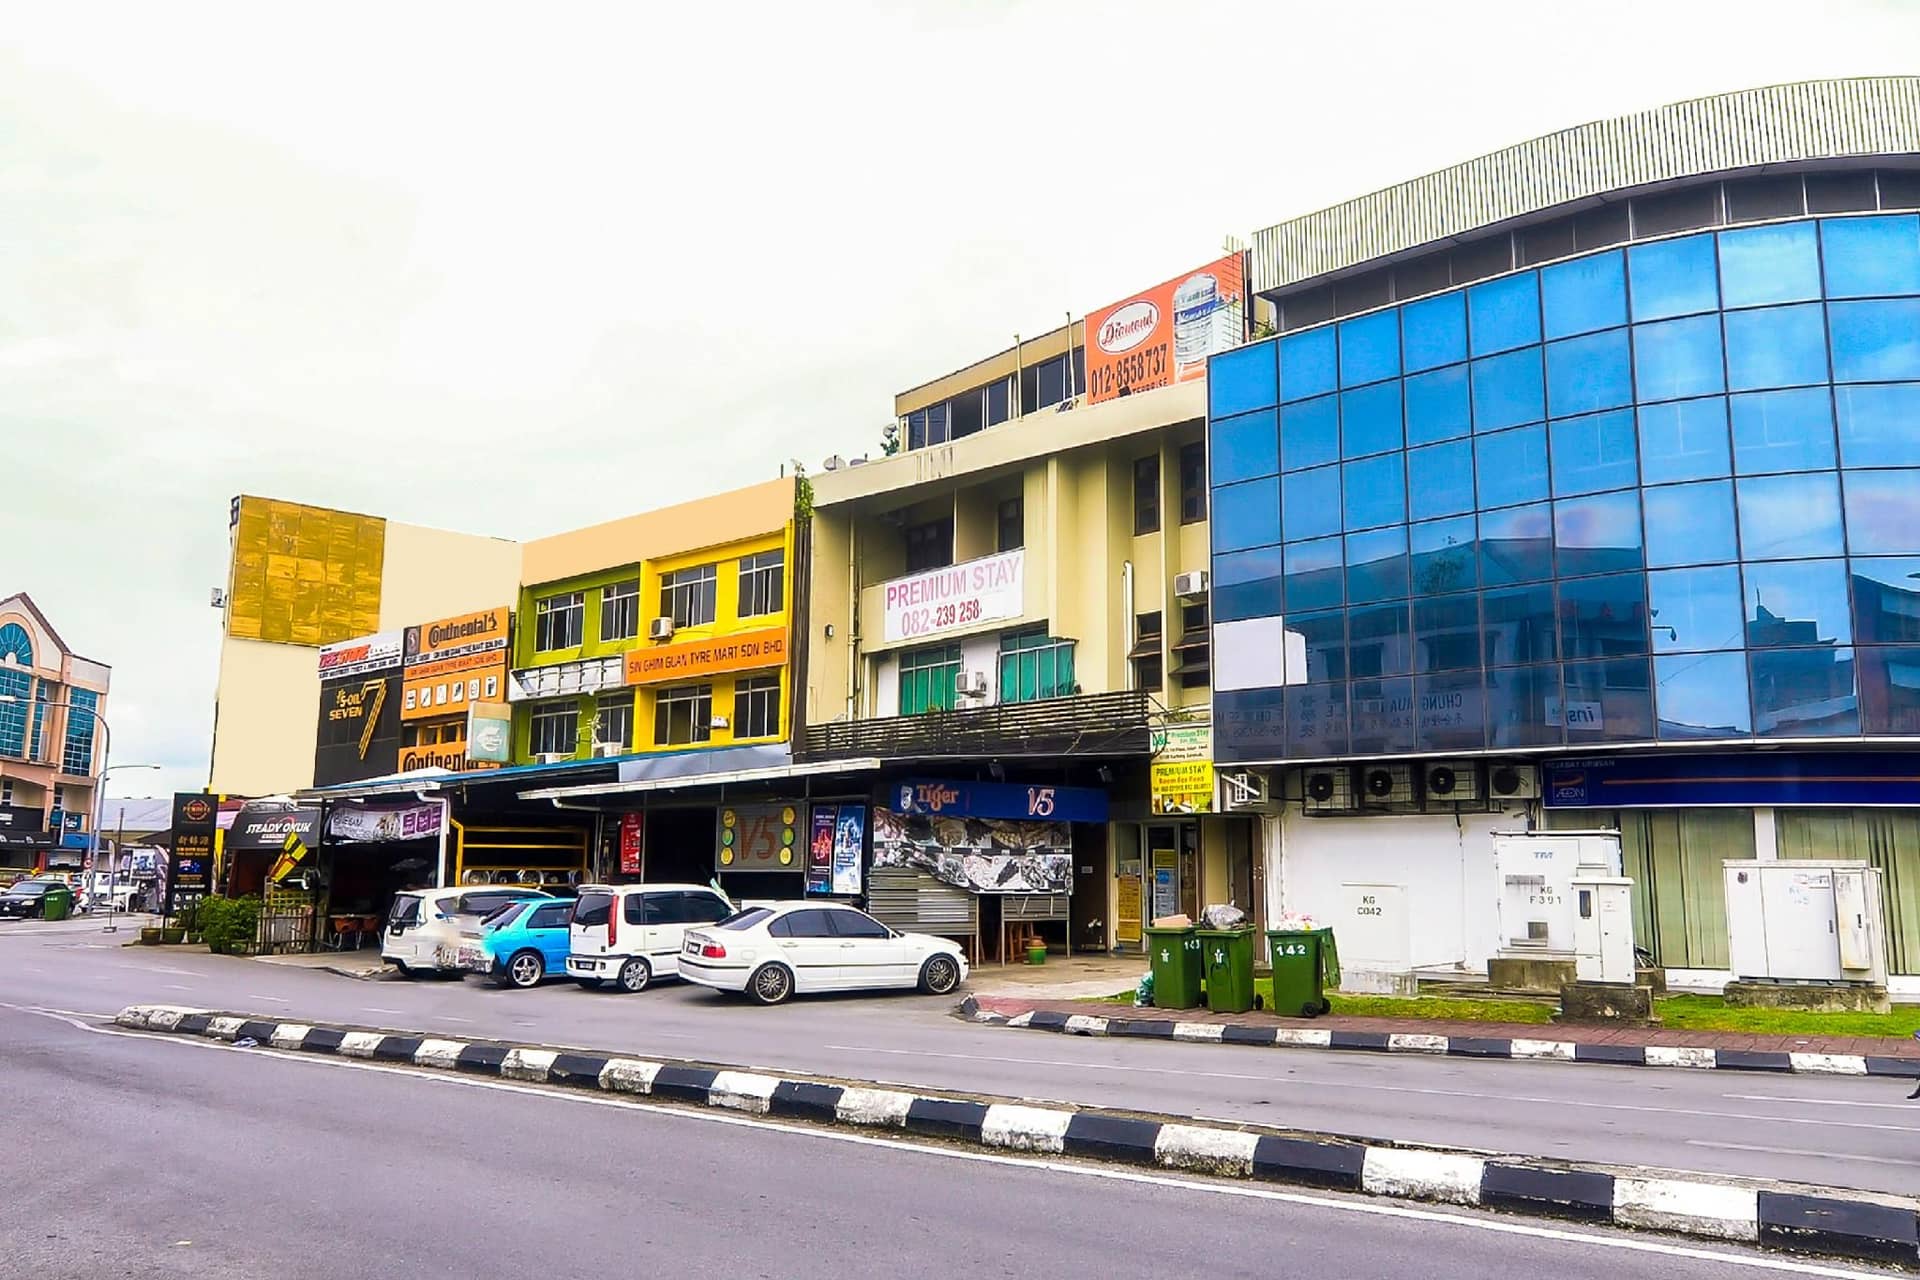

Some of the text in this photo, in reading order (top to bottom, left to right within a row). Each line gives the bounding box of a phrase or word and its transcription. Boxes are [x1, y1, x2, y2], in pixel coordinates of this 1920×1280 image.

[1102, 308, 1153, 346] Diamond
[887, 556, 1020, 611] PREMIUM STAY
[901, 599, 980, 637] 082-239 258
[429, 614, 488, 648] Continental
[629, 661, 642, 674] SIN
[643, 658, 664, 672] GHIM
[690, 650, 711, 665] TYRE
[714, 645, 738, 661] MART
[741, 642, 760, 657] SDN
[764, 639, 783, 654] BHD
[329, 706, 363, 720] SEVEN
[1156, 764, 1207, 776] PREMIUM STAY
[916, 783, 1056, 816] Tiger V5
[245, 823, 283, 834] STEADY
[1540, 886, 1553, 895] KG
[1362, 895, 1376, 905] KG
[1357, 906, 1382, 917] C042
[1276, 944, 1306, 956] 142
